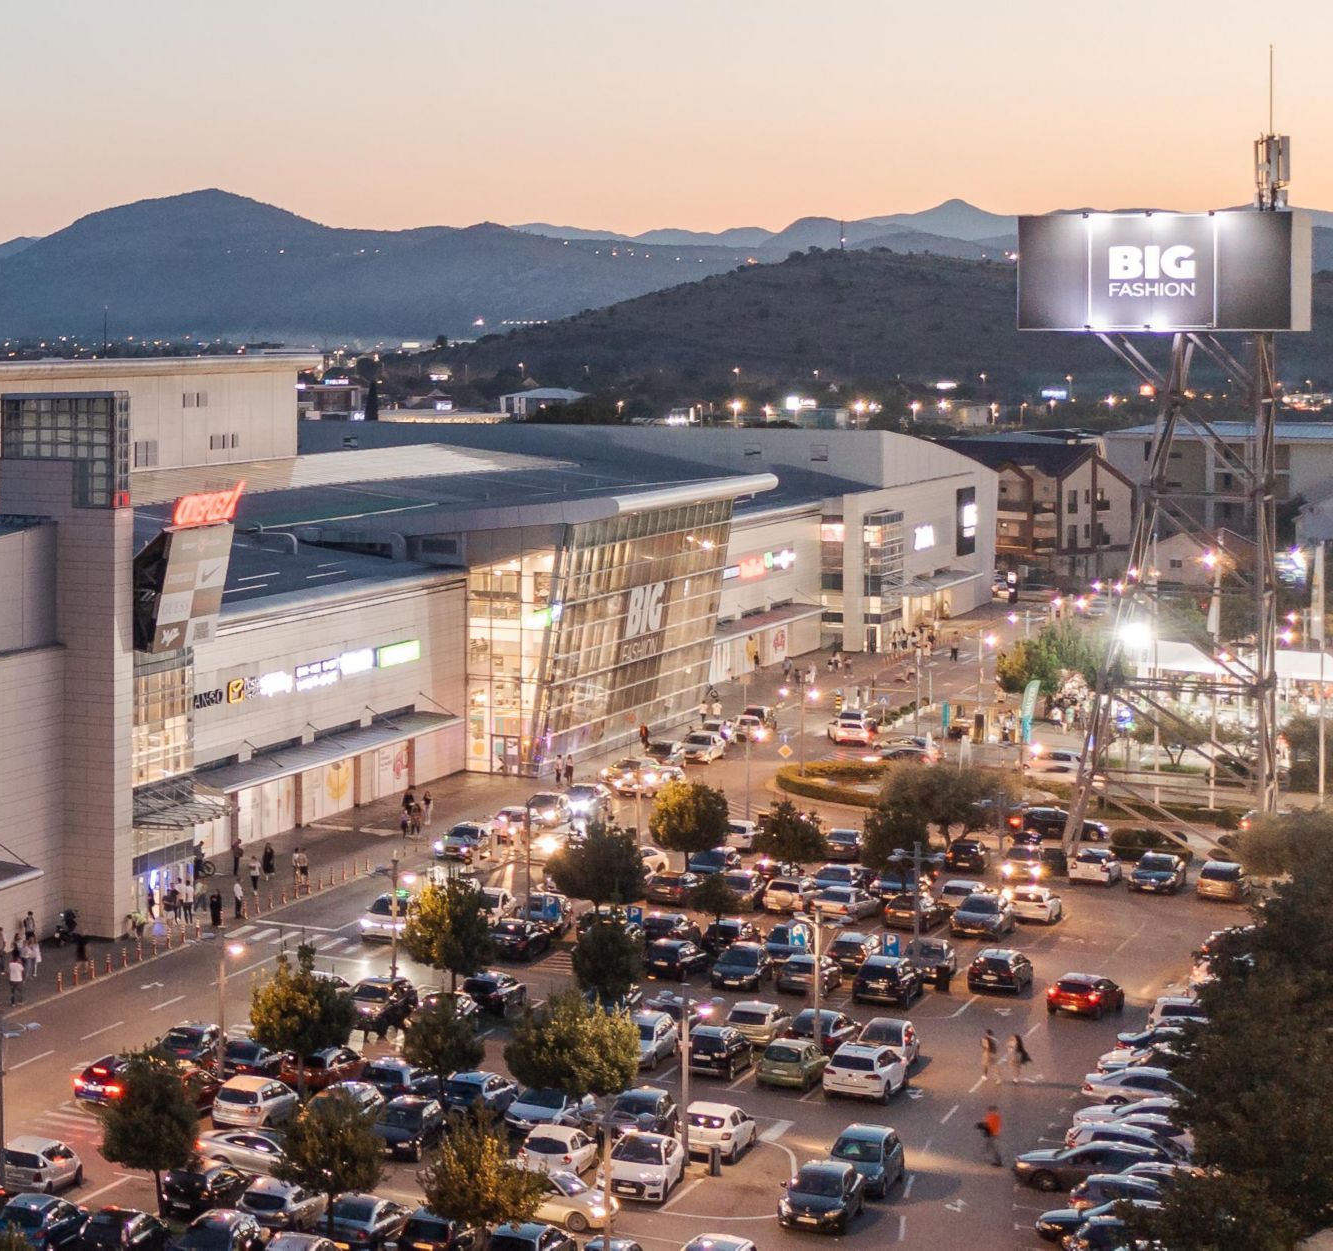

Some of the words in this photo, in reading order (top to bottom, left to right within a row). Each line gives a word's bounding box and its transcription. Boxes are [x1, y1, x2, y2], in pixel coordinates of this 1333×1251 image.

[1108, 244, 1196, 279] BIG
[1108, 282, 1196, 297] FASHION
[625, 581, 665, 639] BIG
